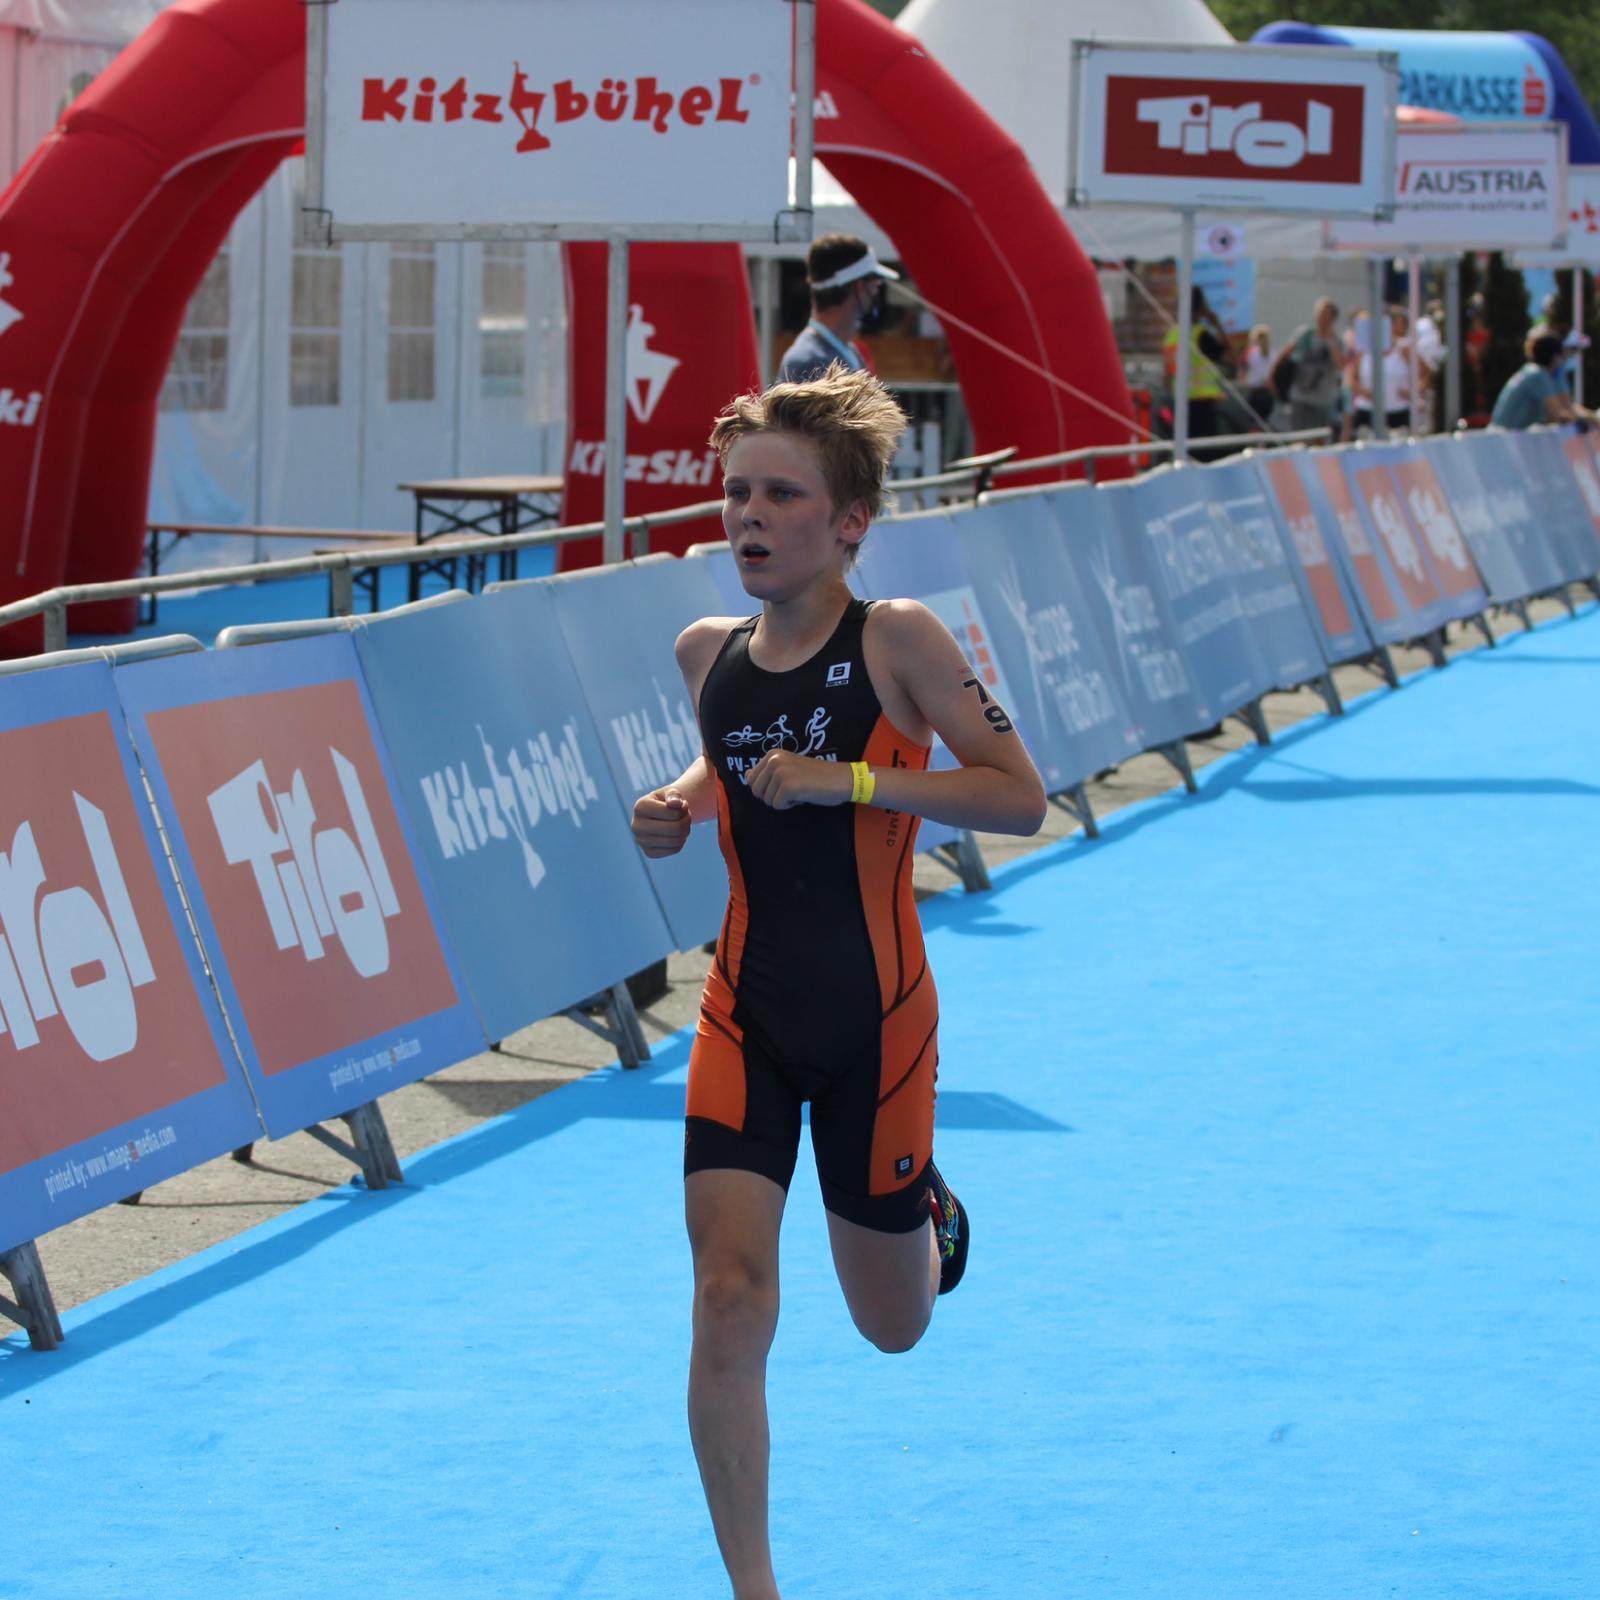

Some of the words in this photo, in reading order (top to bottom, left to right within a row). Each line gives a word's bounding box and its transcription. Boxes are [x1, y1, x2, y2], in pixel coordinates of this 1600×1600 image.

[1397, 70, 1518, 116] PARKASSE
[1136, 95, 1333, 168] Tirol
[1414, 169, 1547, 194] AUSTRIA
[569, 440, 717, 487] KizSki
[207, 746, 401, 979] Tirol
[0, 789, 157, 1063] irol
